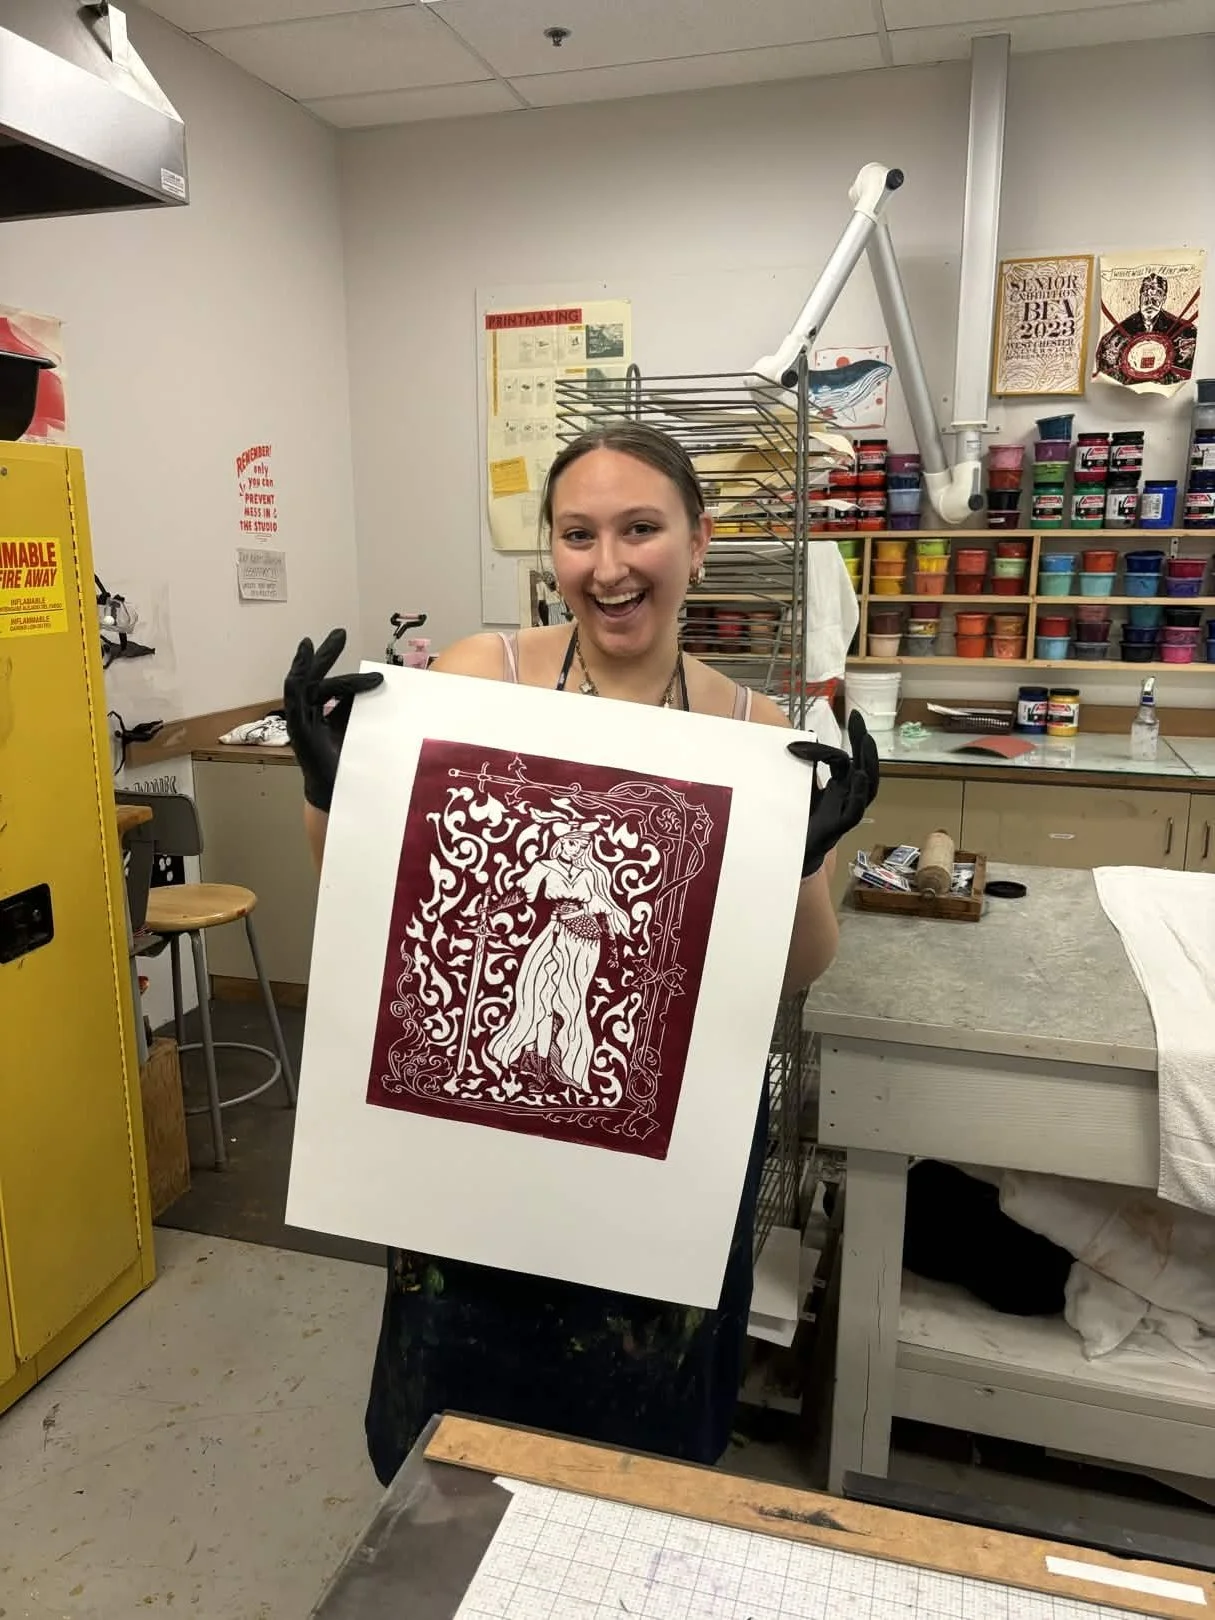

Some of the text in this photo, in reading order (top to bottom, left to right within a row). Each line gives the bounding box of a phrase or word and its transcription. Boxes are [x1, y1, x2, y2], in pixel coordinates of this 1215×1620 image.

[1010, 275, 1078, 292] SENIOR
[1009, 289, 1077, 302] EXHIBITION
[1023, 299, 1075, 321] BFA
[489, 310, 580, 330] PRINTMAKING
[1020, 320, 1075, 339] 2023
[236, 445, 272, 478] REMEMBER!
[253, 462, 269, 477] only
[248, 478, 274, 489] you can
[245, 493, 275, 504] PREVENT
[244, 507, 271, 518] MESS IN
[240, 521, 278, 532] THE STUDIO
[0, 542, 57, 568] MABLE
[24, 568, 57, 588] AWAY
